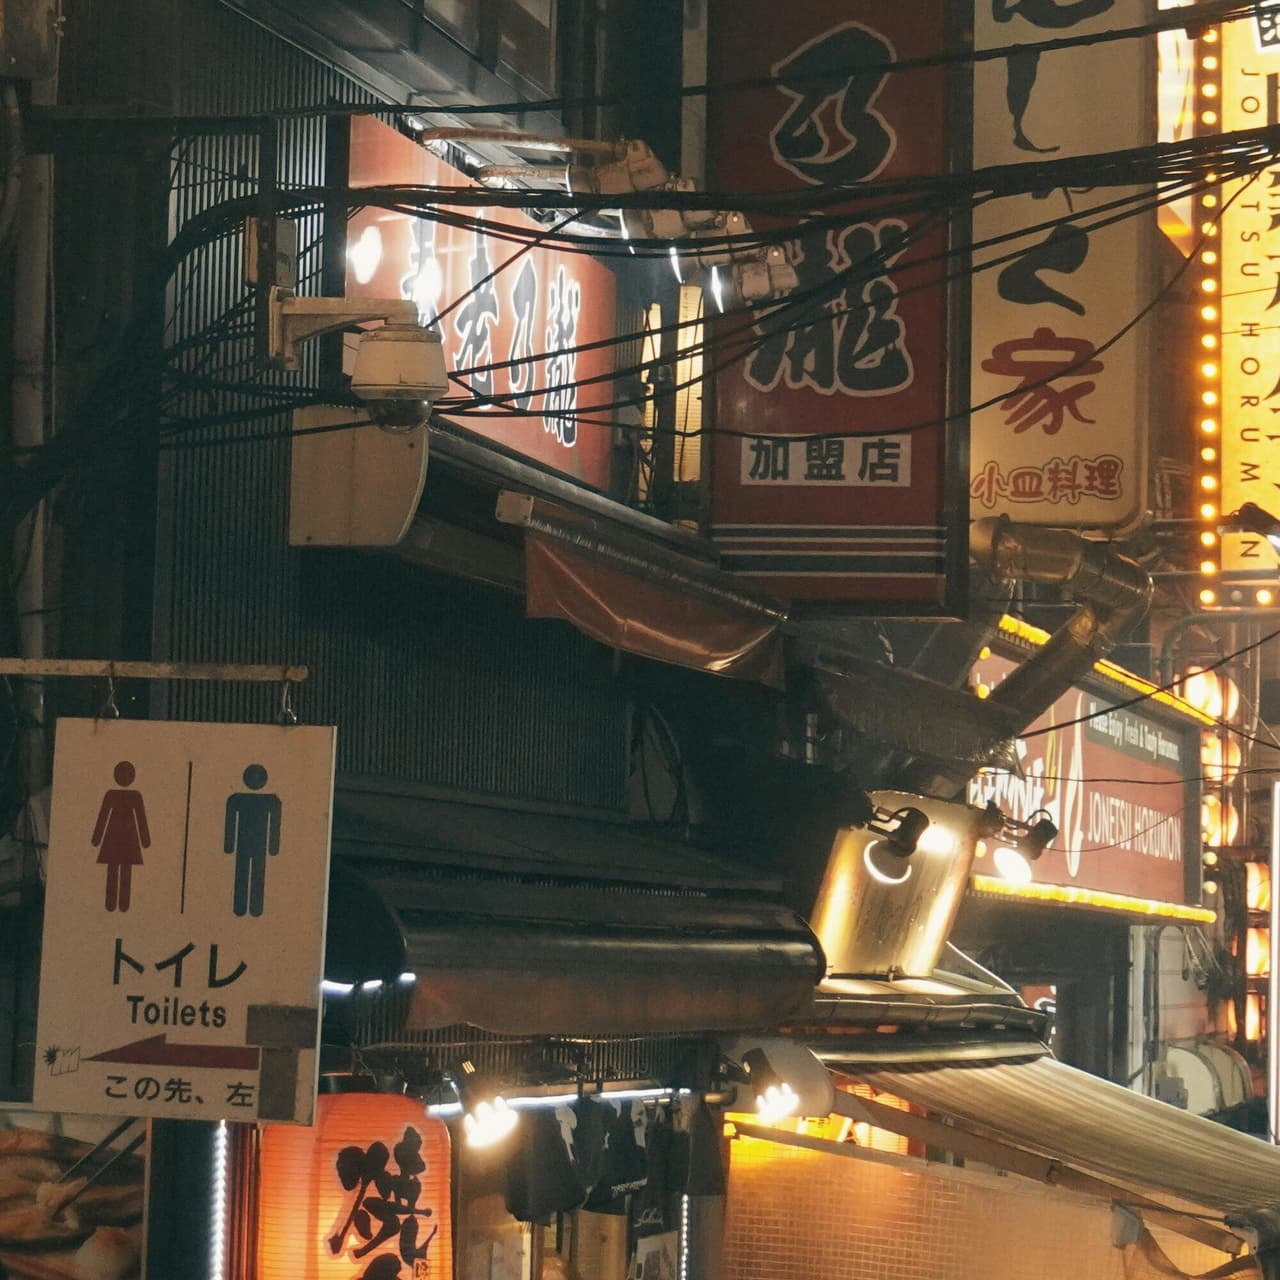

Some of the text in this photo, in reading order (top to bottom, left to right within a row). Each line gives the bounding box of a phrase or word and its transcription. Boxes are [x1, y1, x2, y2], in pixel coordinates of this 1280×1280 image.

[1240, 68, 1260, 557] JOTSU HORUMN
[749, 438, 901, 483] 加盟店
[972, 456, 1124, 505] 小皿料理
[1088, 791, 1132, 851] JONETSU
[1134, 803, 1181, 862] HORUMON
[112, 938, 248, 989] トイレ
[127, 995, 227, 1028] Toilets
[105, 1075, 255, 1107] この先、左
